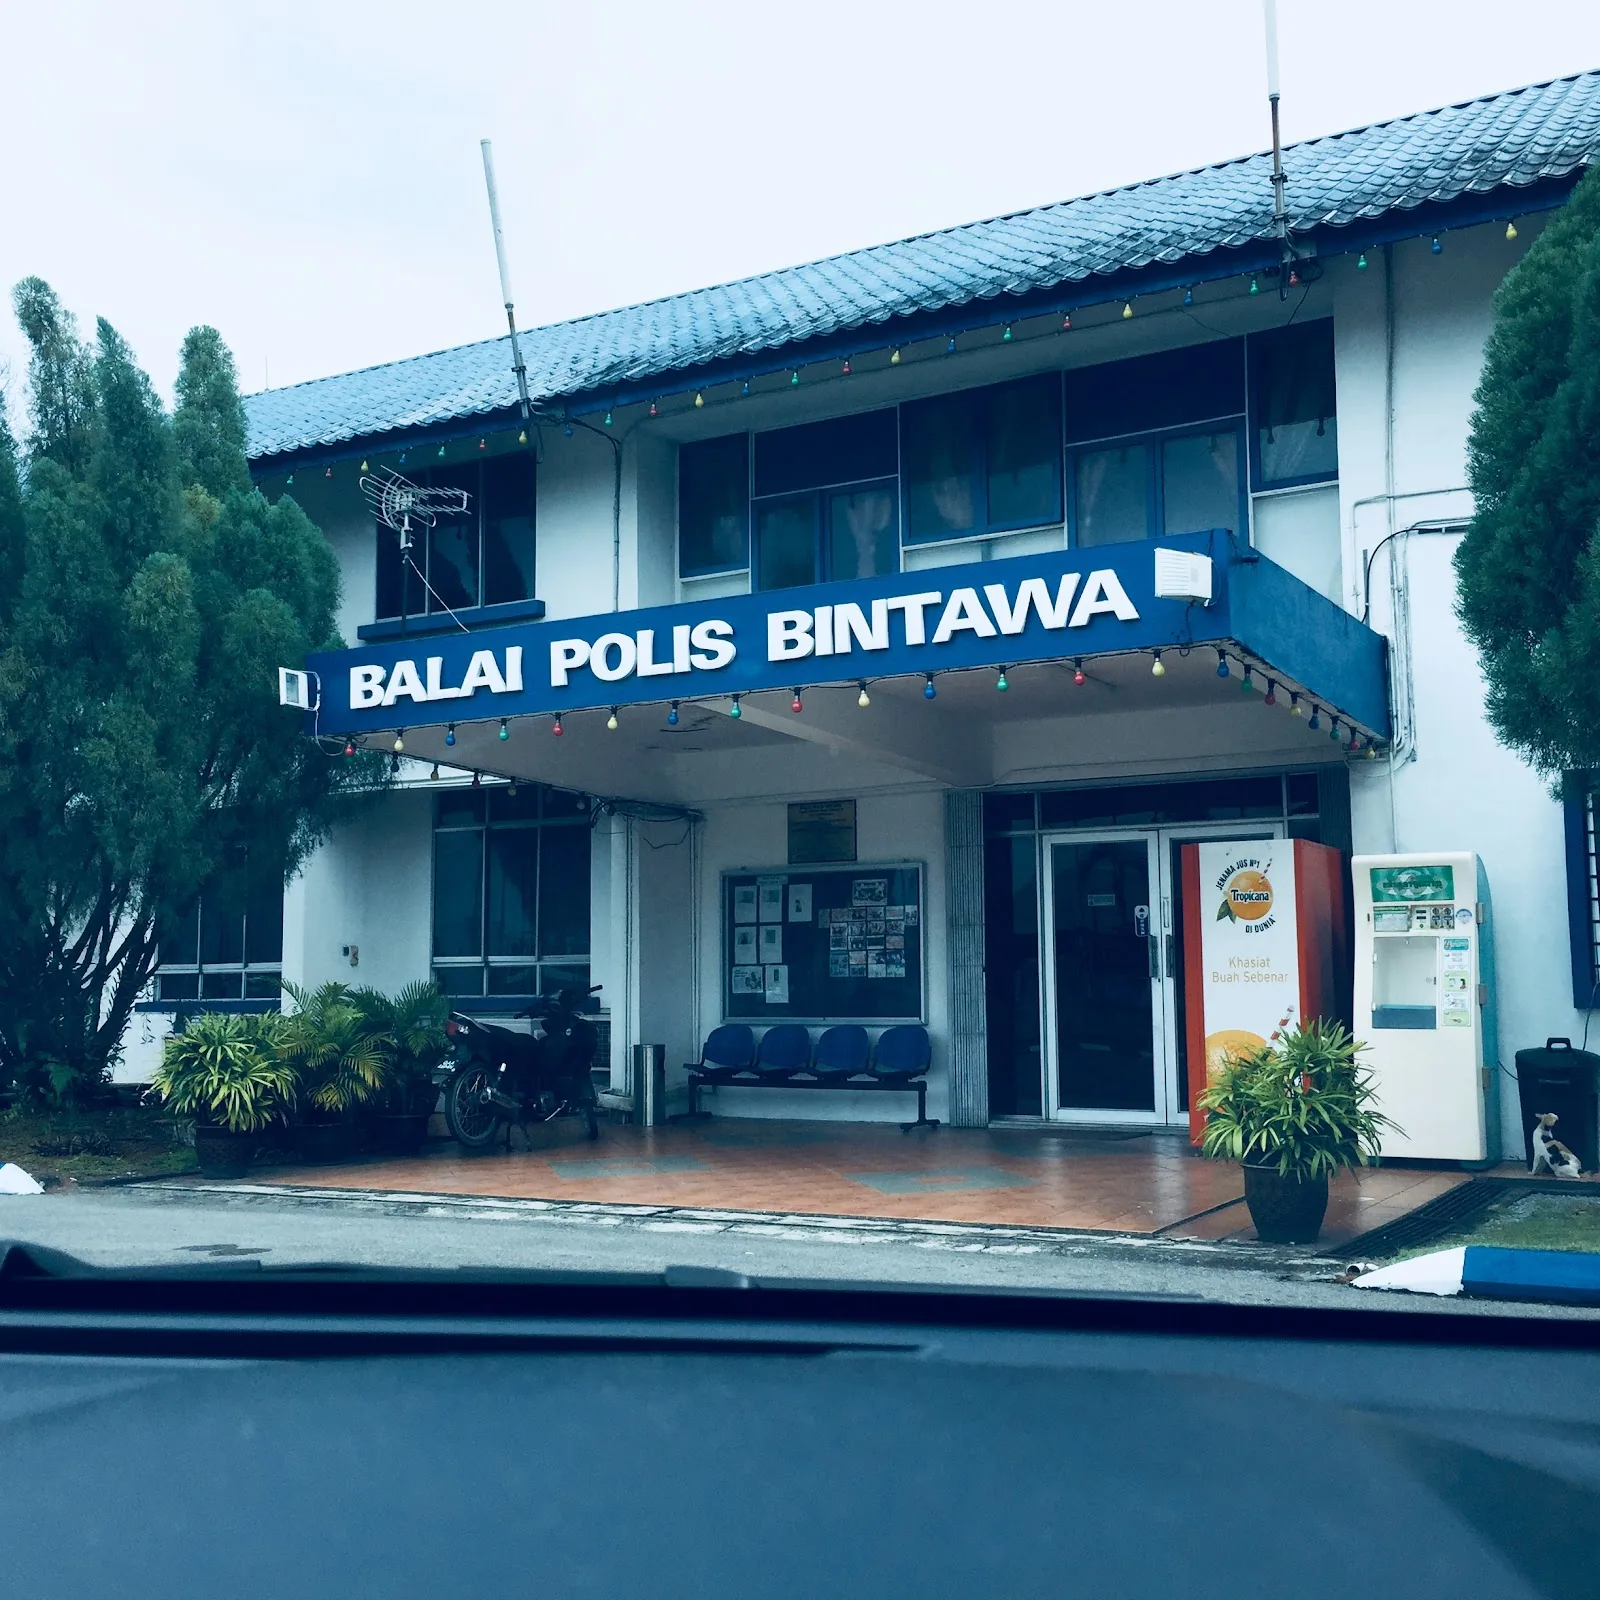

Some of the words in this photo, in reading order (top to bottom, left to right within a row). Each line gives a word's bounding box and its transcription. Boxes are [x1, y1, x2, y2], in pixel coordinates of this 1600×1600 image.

[350, 646, 523, 710] BALAI
[550, 620, 737, 687] POLIS
[767, 568, 1140, 662] BINTAWA
[1215, 865, 1237, 891] JENAMA
[1236, 859, 1248, 870] JUS
[1230, 889, 1270, 902] Tropicana
[1245, 925, 1253, 934] DI
[1228, 956, 1271, 969] Khasiat
[1212, 971, 1240, 983] Buah
[1243, 971, 1289, 983] Sebenar
